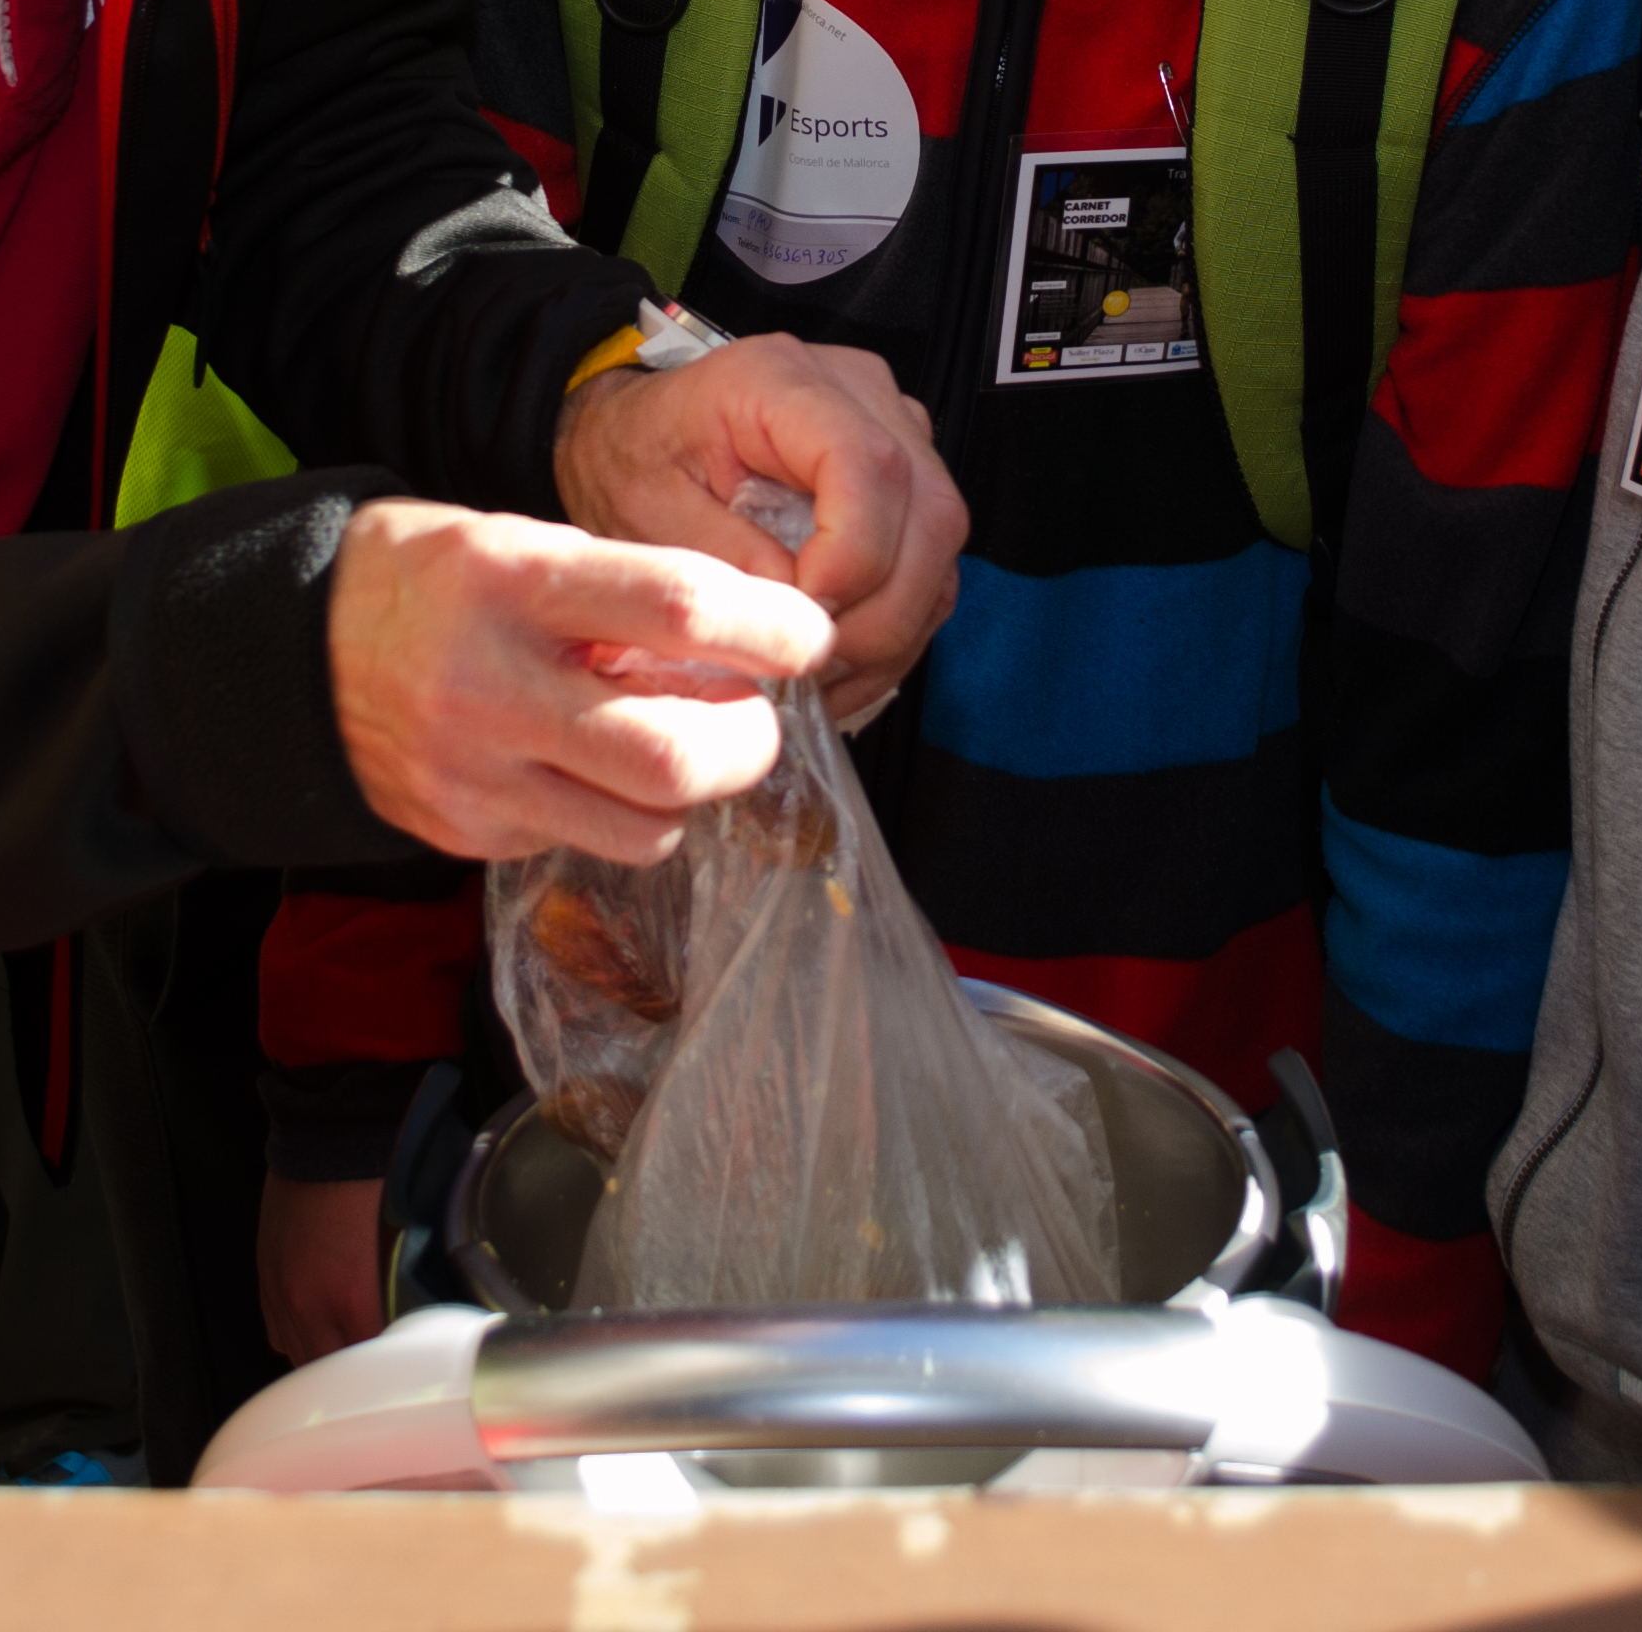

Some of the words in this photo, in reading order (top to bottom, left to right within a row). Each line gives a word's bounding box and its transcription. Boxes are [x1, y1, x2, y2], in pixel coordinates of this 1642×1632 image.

[791, 108, 888, 143] Esports
[789, 153, 824, 169] Consell
[826, 156, 841, 169] de
[843, 156, 890, 169] Mallorca
[1064, 201, 1111, 212] CARNET
[1063, 213, 1127, 225] CORREDOR
